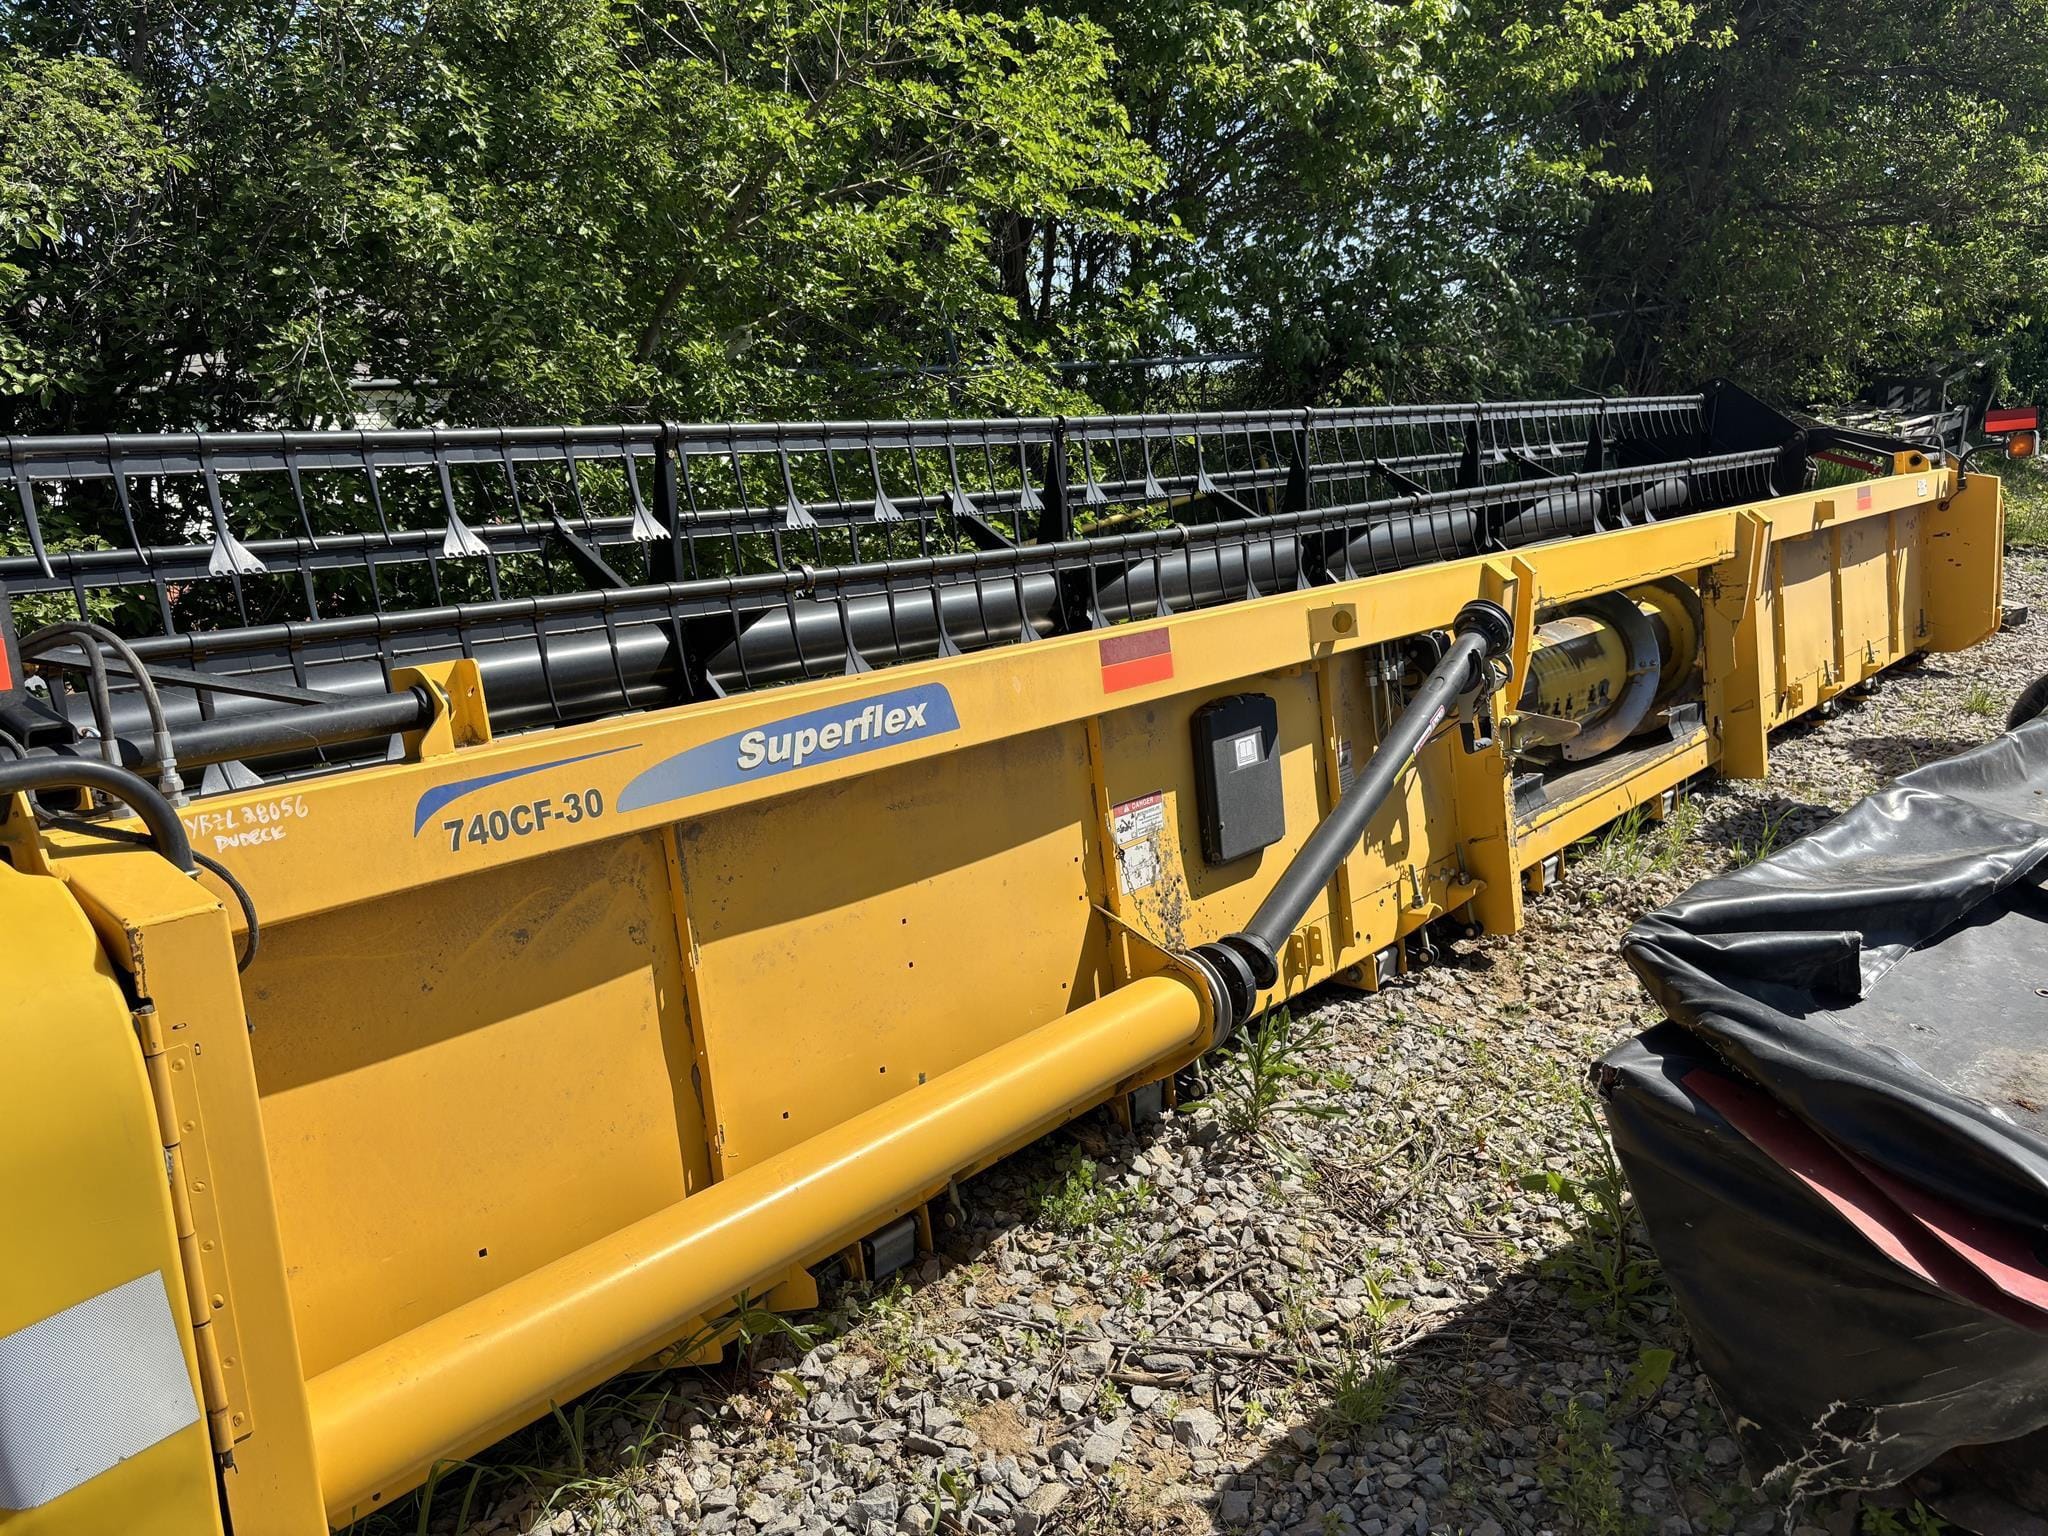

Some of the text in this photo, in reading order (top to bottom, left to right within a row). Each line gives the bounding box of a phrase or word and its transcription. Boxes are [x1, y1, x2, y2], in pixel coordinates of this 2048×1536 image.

[737, 702, 928, 771] Superflex
[241, 795, 309, 824] 28056
[443, 788, 604, 852] 740CF-30
[1131, 797, 1154, 809] DANGER
